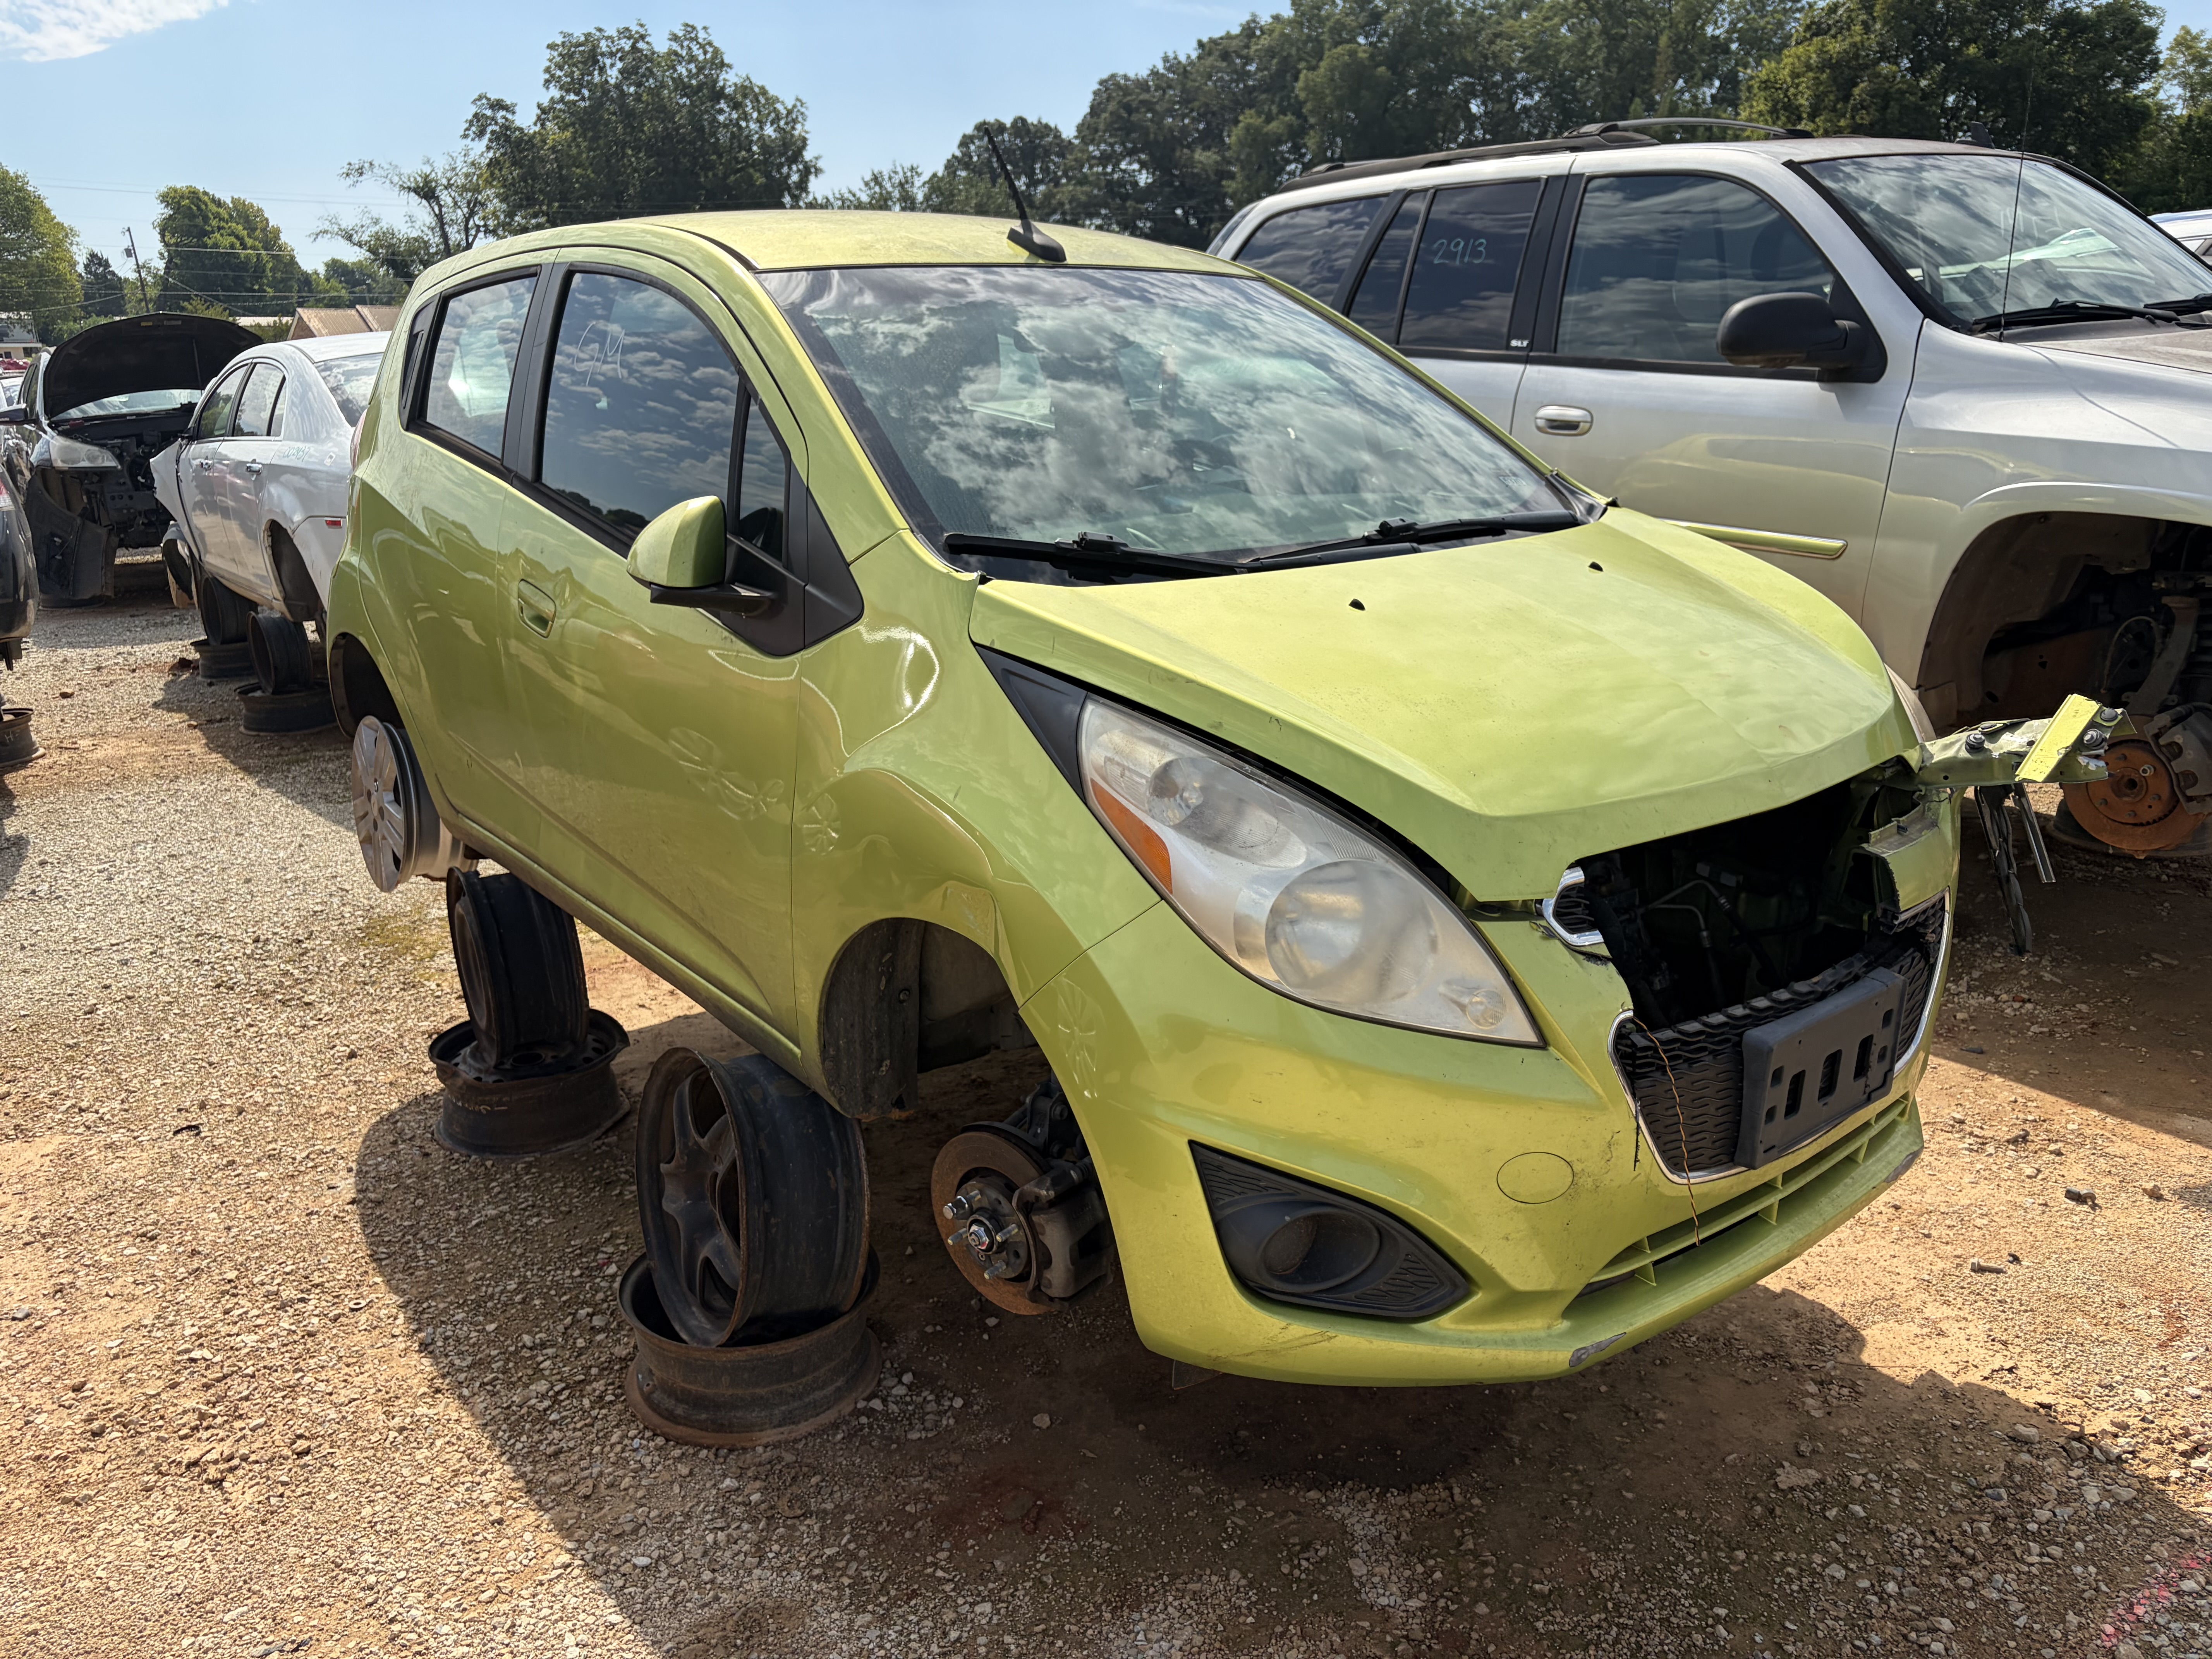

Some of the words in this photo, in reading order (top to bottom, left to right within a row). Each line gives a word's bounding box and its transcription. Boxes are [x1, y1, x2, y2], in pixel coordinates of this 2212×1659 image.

[1432, 238, 1487, 265] 2913
[574, 321, 625, 386] GM
[1510, 339, 1529, 347] SLT
